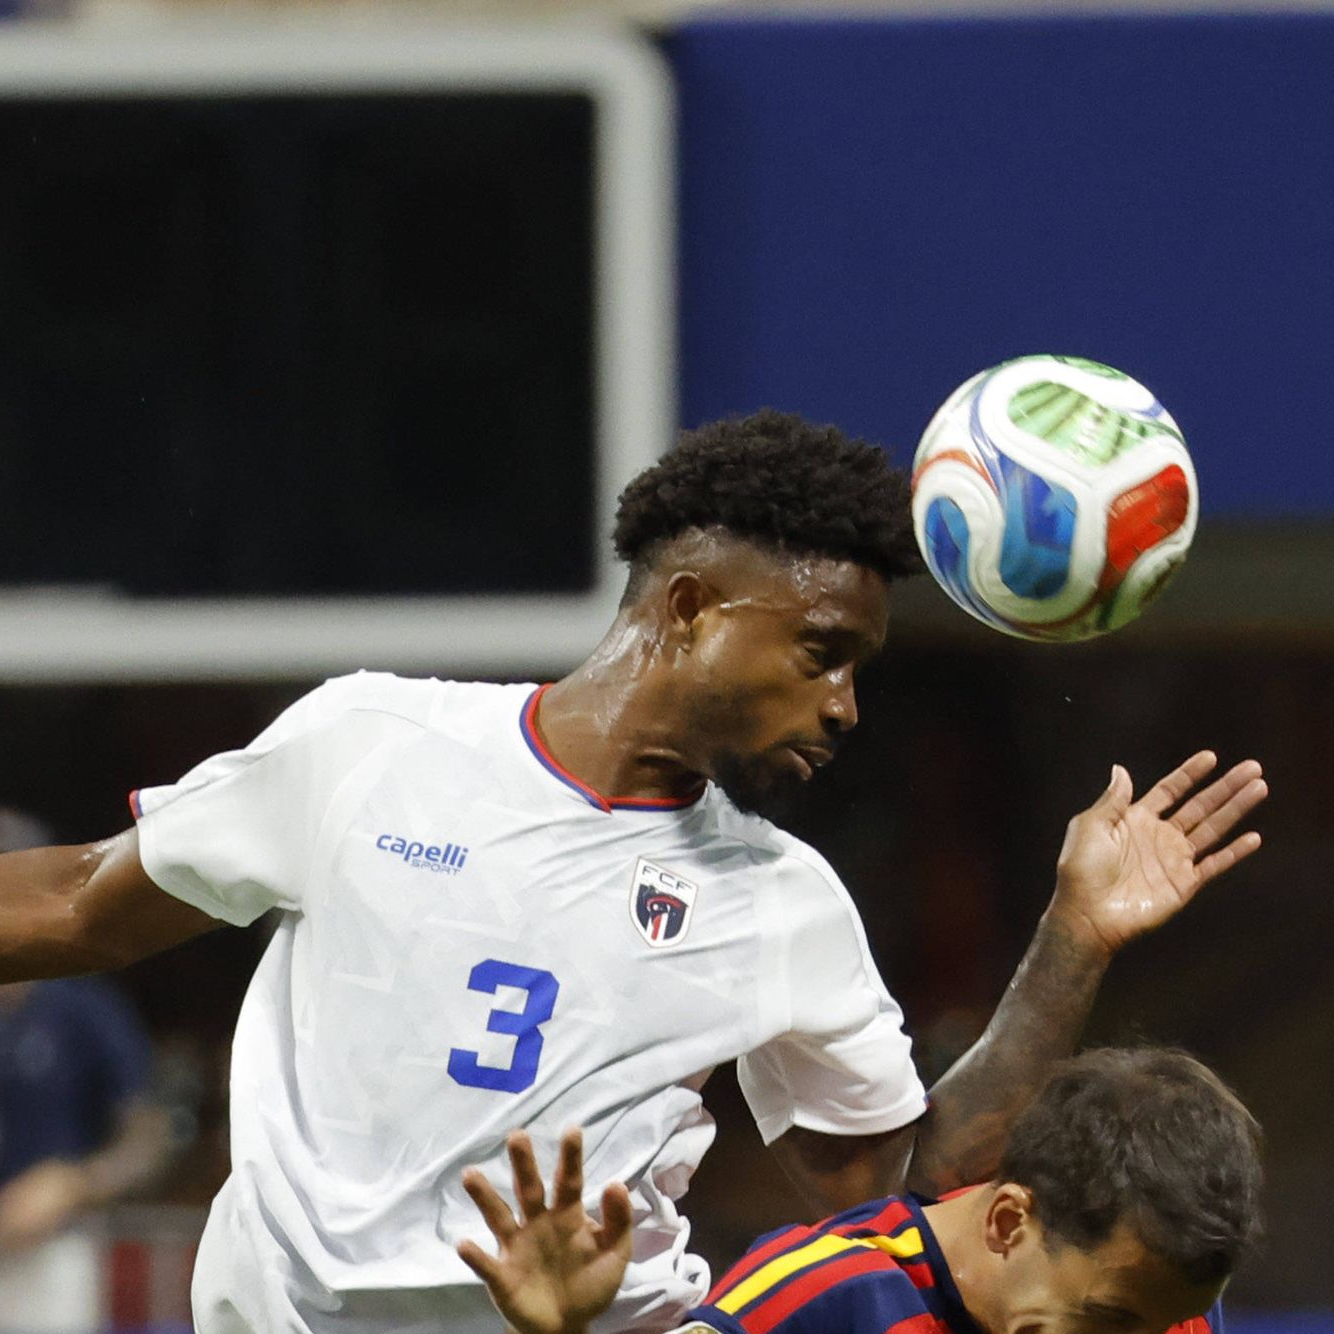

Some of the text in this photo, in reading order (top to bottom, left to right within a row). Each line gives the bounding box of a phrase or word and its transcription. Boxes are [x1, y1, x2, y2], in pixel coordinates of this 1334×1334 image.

[376, 834, 470, 869] capelli
[410, 859, 461, 876] SPORT
[642, 865, 693, 890] FCF
[447, 958, 560, 1094] 3
